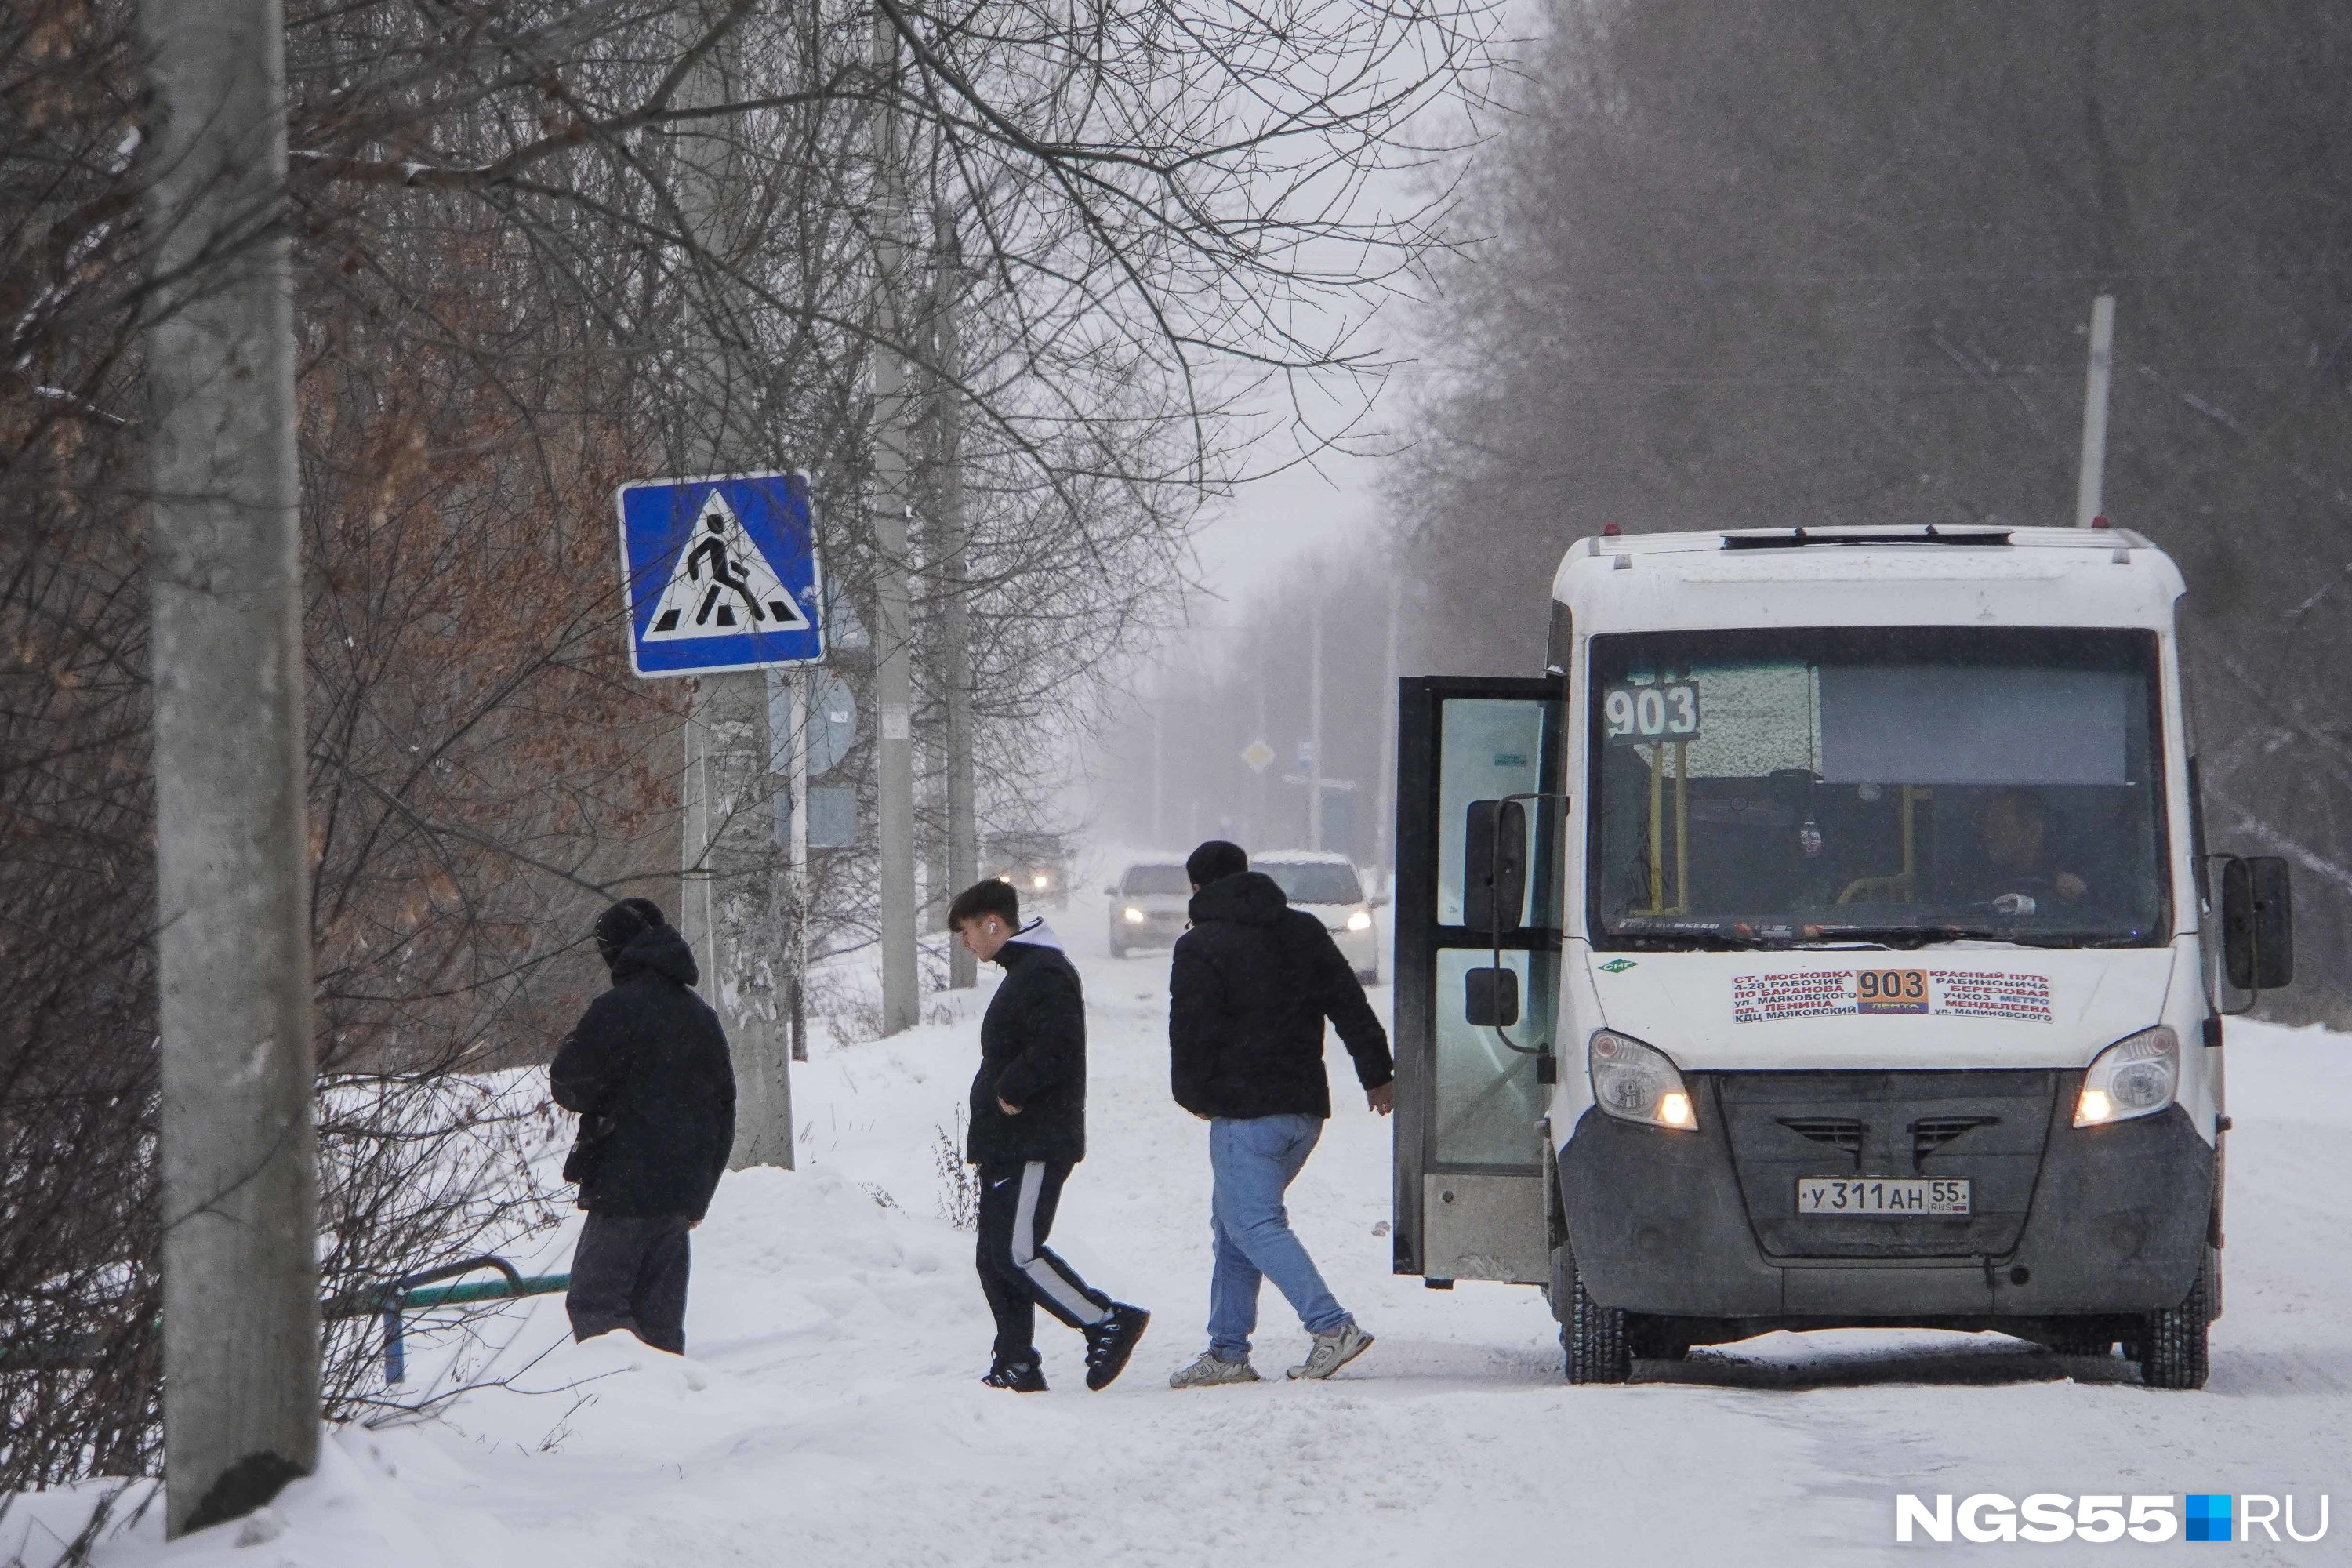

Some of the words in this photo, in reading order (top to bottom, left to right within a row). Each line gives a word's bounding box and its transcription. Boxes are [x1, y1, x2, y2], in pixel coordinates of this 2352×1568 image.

[1606, 686, 1697, 738] 903
[1764, 971, 1853, 981] МОСКОВКА
[1929, 970, 2005, 979] КРАСНЫЙ
[2009, 973, 2049, 982] ПУТЬ
[1770, 978, 1844, 988] РАБОЧИЕ
[1860, 971, 1925, 998] 903
[1936, 978, 2049, 989] РАБИНОВИЧА
[1734, 990, 1756, 999] ПО
[1761, 985, 1845, 996] БАРАНОВА
[1950, 985, 2049, 997] БЕРЕЗОВАЯ
[1734, 1000, 1754, 1008] ул.
[1757, 992, 1857, 1004] МАЯКОВСКОГО
[1943, 992, 1991, 1000] УЧХОЗ
[1999, 995, 2050, 1005] МЕТРО
[1763, 1000, 1834, 1012] ЛЕНИНА
[1945, 1000, 2050, 1014] МЕНДЕЛЕЕВА
[1735, 1013, 1763, 1023] КДЦ
[1766, 1006, 1857, 1020] МАЯКОВСКИЙ
[1955, 1008, 2052, 1022] МАЛИНОВСКОГО
[1932, 1181, 1960, 1203] 55
[1931, 1203, 1951, 1212] RUS
